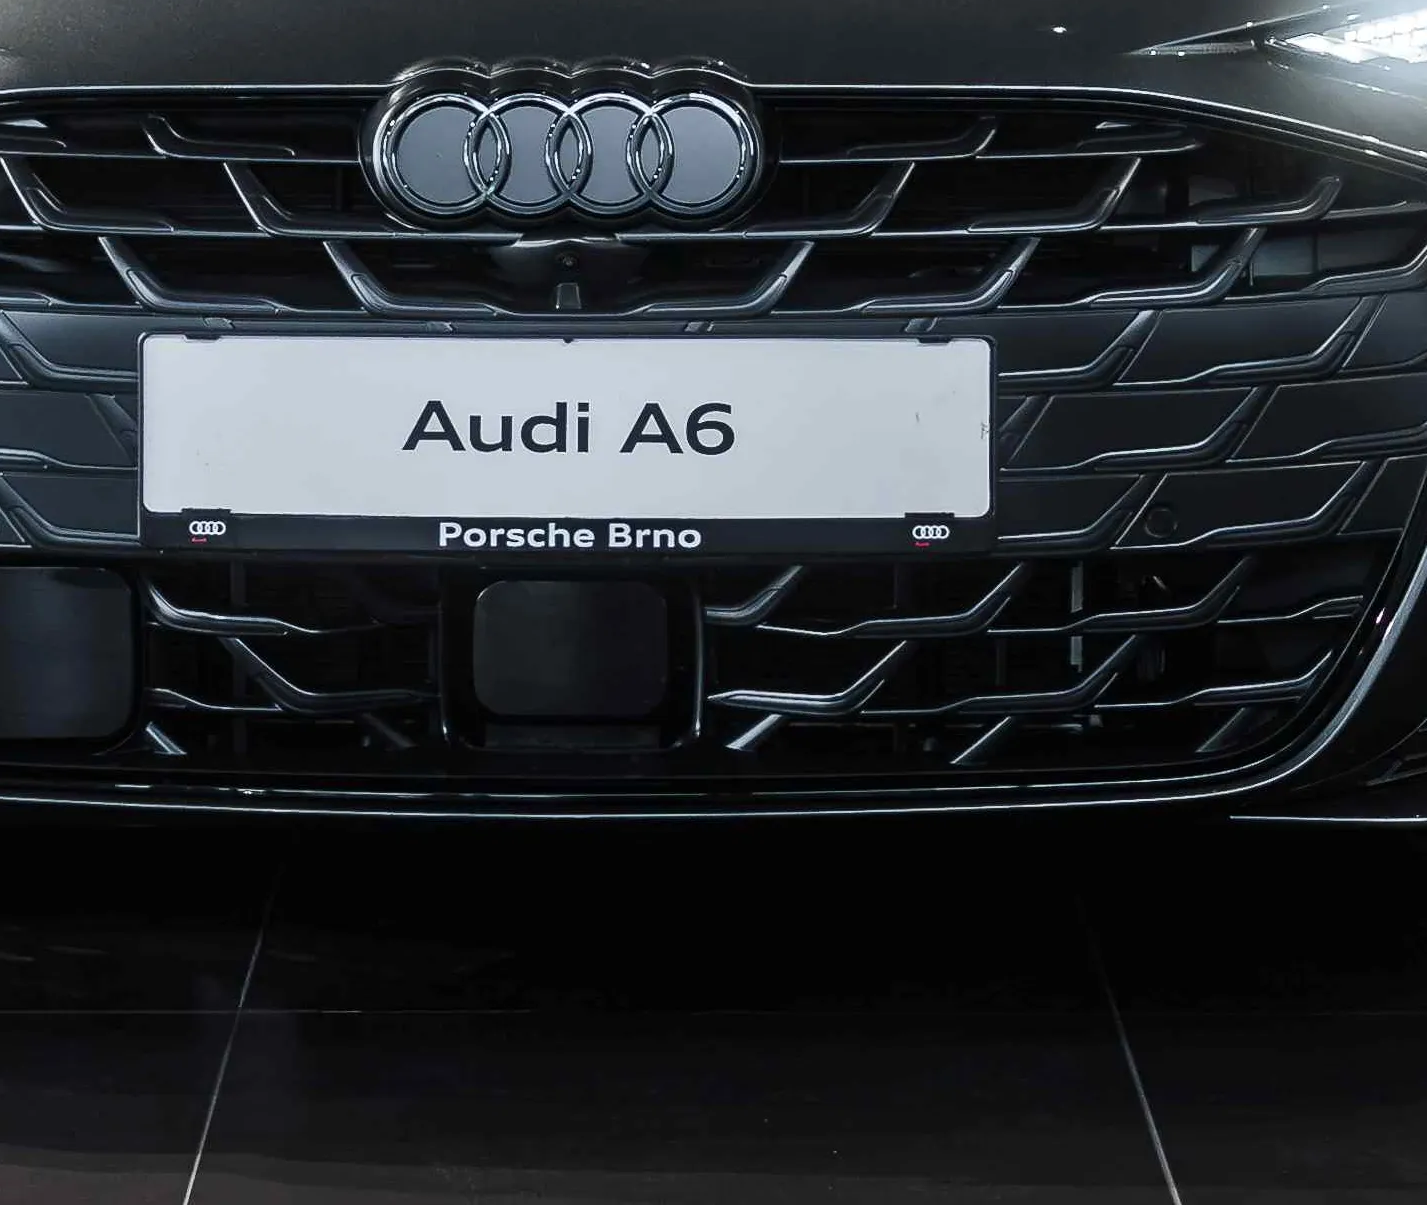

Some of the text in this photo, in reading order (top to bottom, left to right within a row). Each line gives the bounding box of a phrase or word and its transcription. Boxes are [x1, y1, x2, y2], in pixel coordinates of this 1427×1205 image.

[402, 400, 735, 456] Audi A6
[439, 522, 702, 549] Porsche Brno
